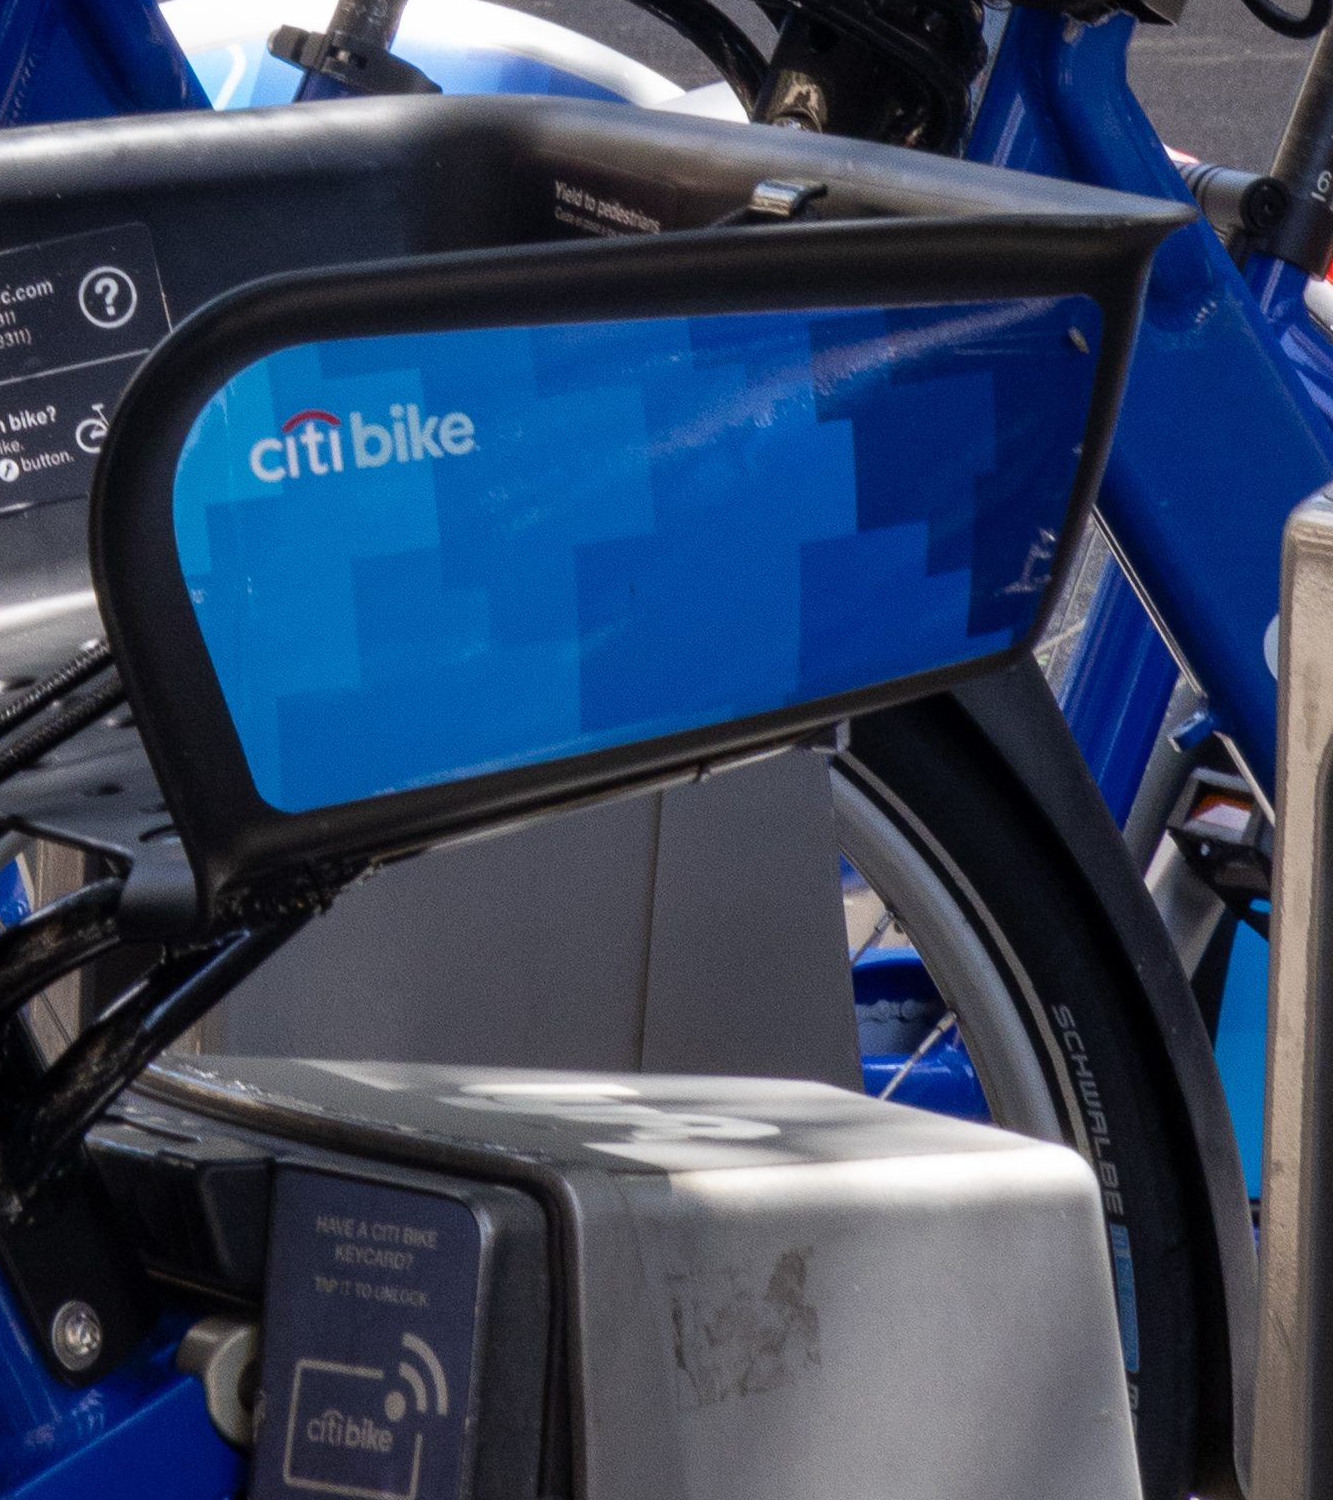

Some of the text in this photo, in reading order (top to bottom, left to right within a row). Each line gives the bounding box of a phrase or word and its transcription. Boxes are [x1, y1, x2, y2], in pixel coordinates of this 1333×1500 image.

[7, 404, 58, 432] bike?
[250, 404, 477, 482] citi bike
[20, 451, 76, 473] button.
[1052, 1003, 1125, 1217] SCHWALBE
[316, 1215, 438, 1250] HAVE A CITI BIKE
[335, 1243, 414, 1270] KEYCARD?
[354, 1282, 374, 1300] TO
[307, 1408, 394, 1453] citi bike
